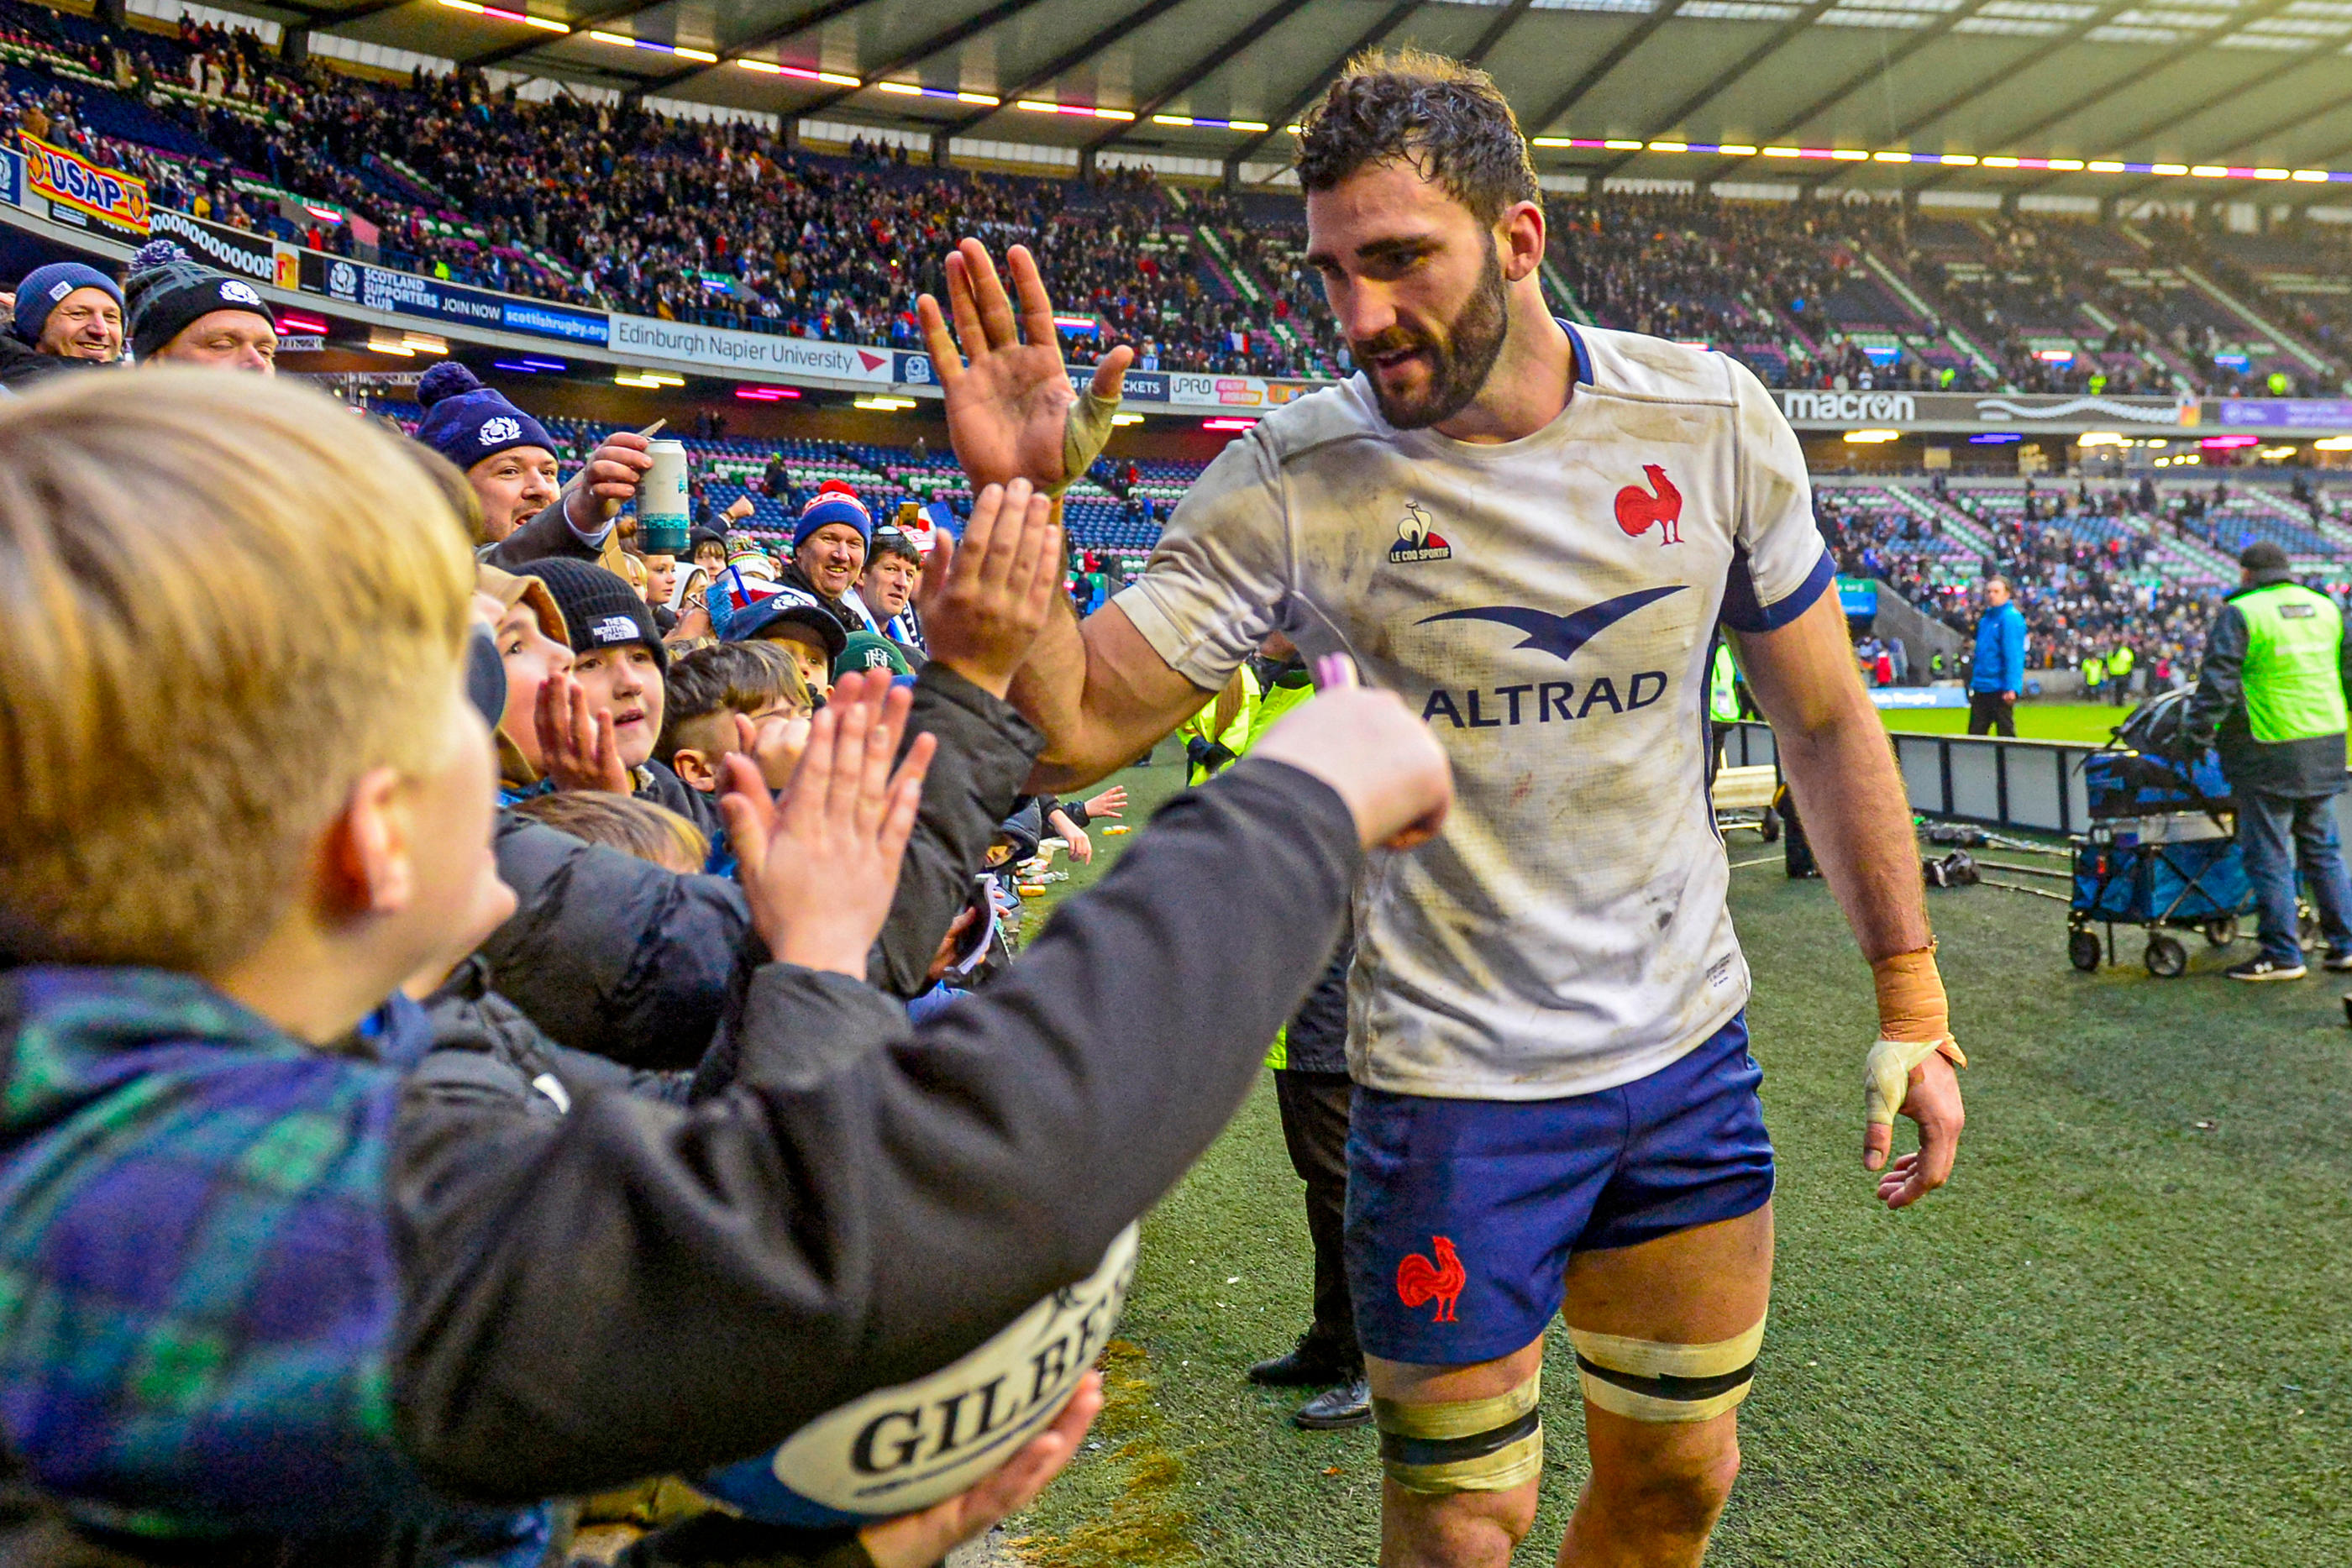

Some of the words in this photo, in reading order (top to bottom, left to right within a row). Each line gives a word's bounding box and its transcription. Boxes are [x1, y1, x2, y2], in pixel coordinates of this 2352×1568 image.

[46, 152, 123, 211] USAP
[364, 267, 425, 292] SCOTLAND
[364, 281, 439, 308] SUPPORTERS
[364, 294, 394, 312] CLUB
[442, 297, 470, 315] JOIN
[471, 303, 501, 321] NOW
[506, 310, 608, 341] scottishrugby.org
[619, 322, 704, 356] Edinburgh
[709, 336, 766, 361] Napier
[771, 343, 853, 374] University
[1121, 380, 1161, 395] CKETS
[1784, 392, 1916, 421] macron
[1390, 551, 1401, 562] LE
[1401, 550, 1418, 561] COQ
[1419, 548, 1450, 559] SPORTIF
[603, 632, 625, 642] FACE
[1421, 670, 1668, 729] ALTRAD
